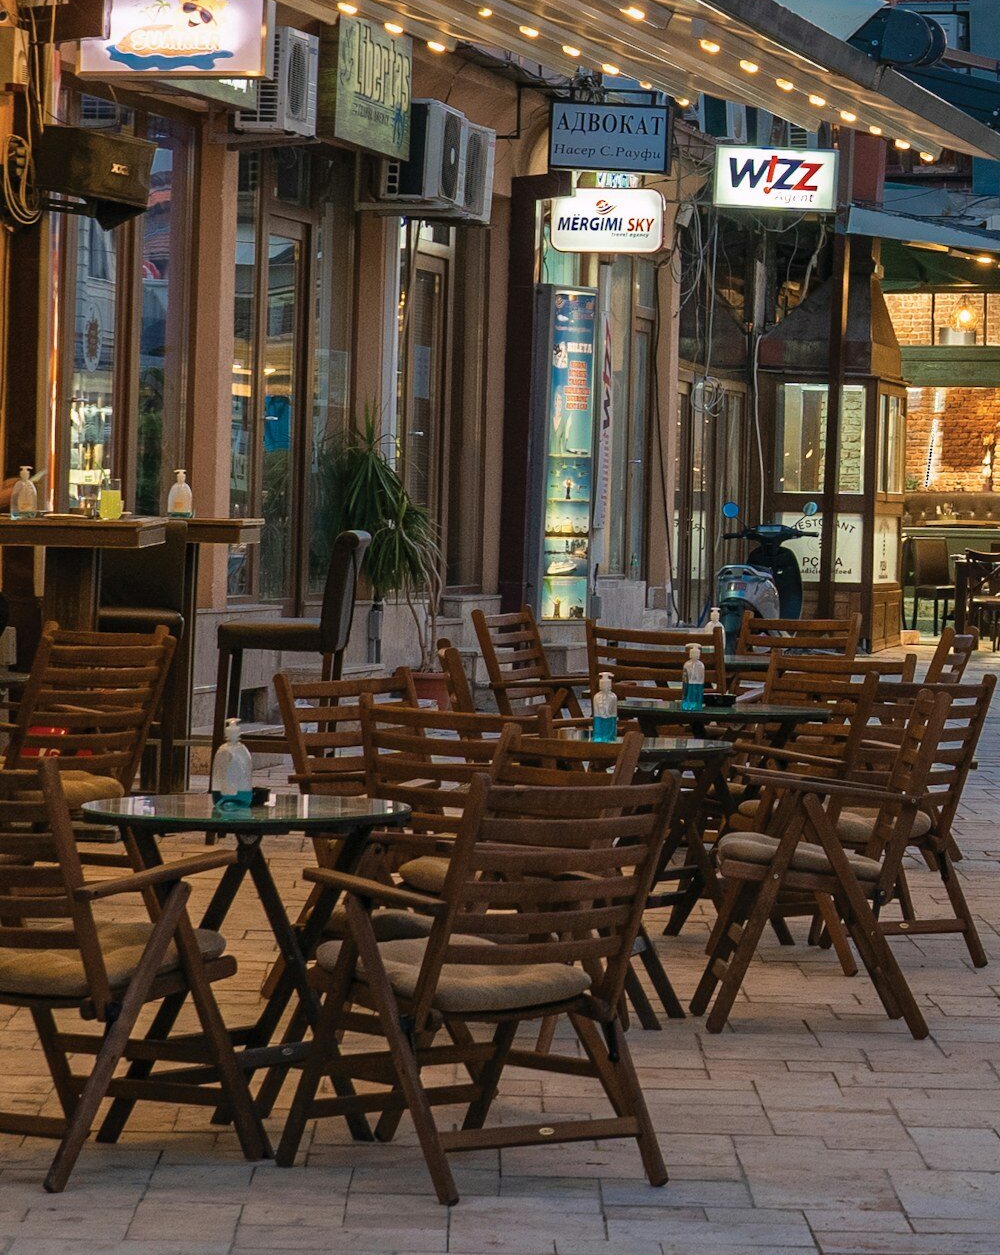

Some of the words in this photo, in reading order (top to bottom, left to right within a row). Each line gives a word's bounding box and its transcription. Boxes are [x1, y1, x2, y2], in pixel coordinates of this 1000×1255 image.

[556, 111, 664, 136] АДВОКАТ
[554, 144, 596, 158] Насер
[557, 213, 623, 232] MËRGIMI
[627, 218, 655, 232] SKY
[802, 557, 843, 569] PÇA
